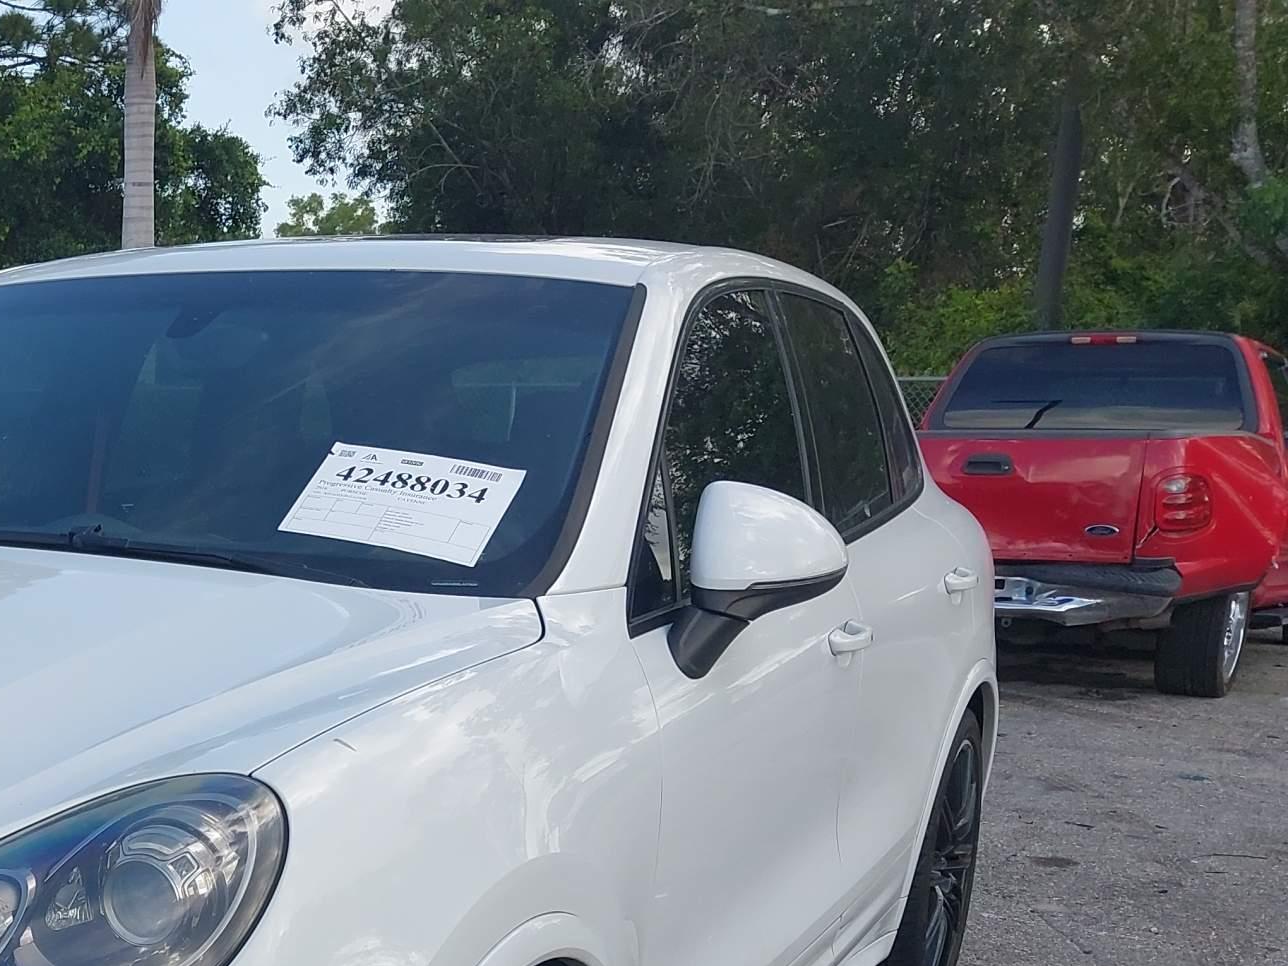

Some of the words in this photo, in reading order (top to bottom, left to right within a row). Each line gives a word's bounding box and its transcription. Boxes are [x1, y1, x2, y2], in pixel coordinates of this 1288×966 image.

[318, 479, 363, 490] Progressive
[364, 485, 398, 496] Casualty
[399, 490, 438, 502] Insurance
[335, 465, 489, 504] 42488034
